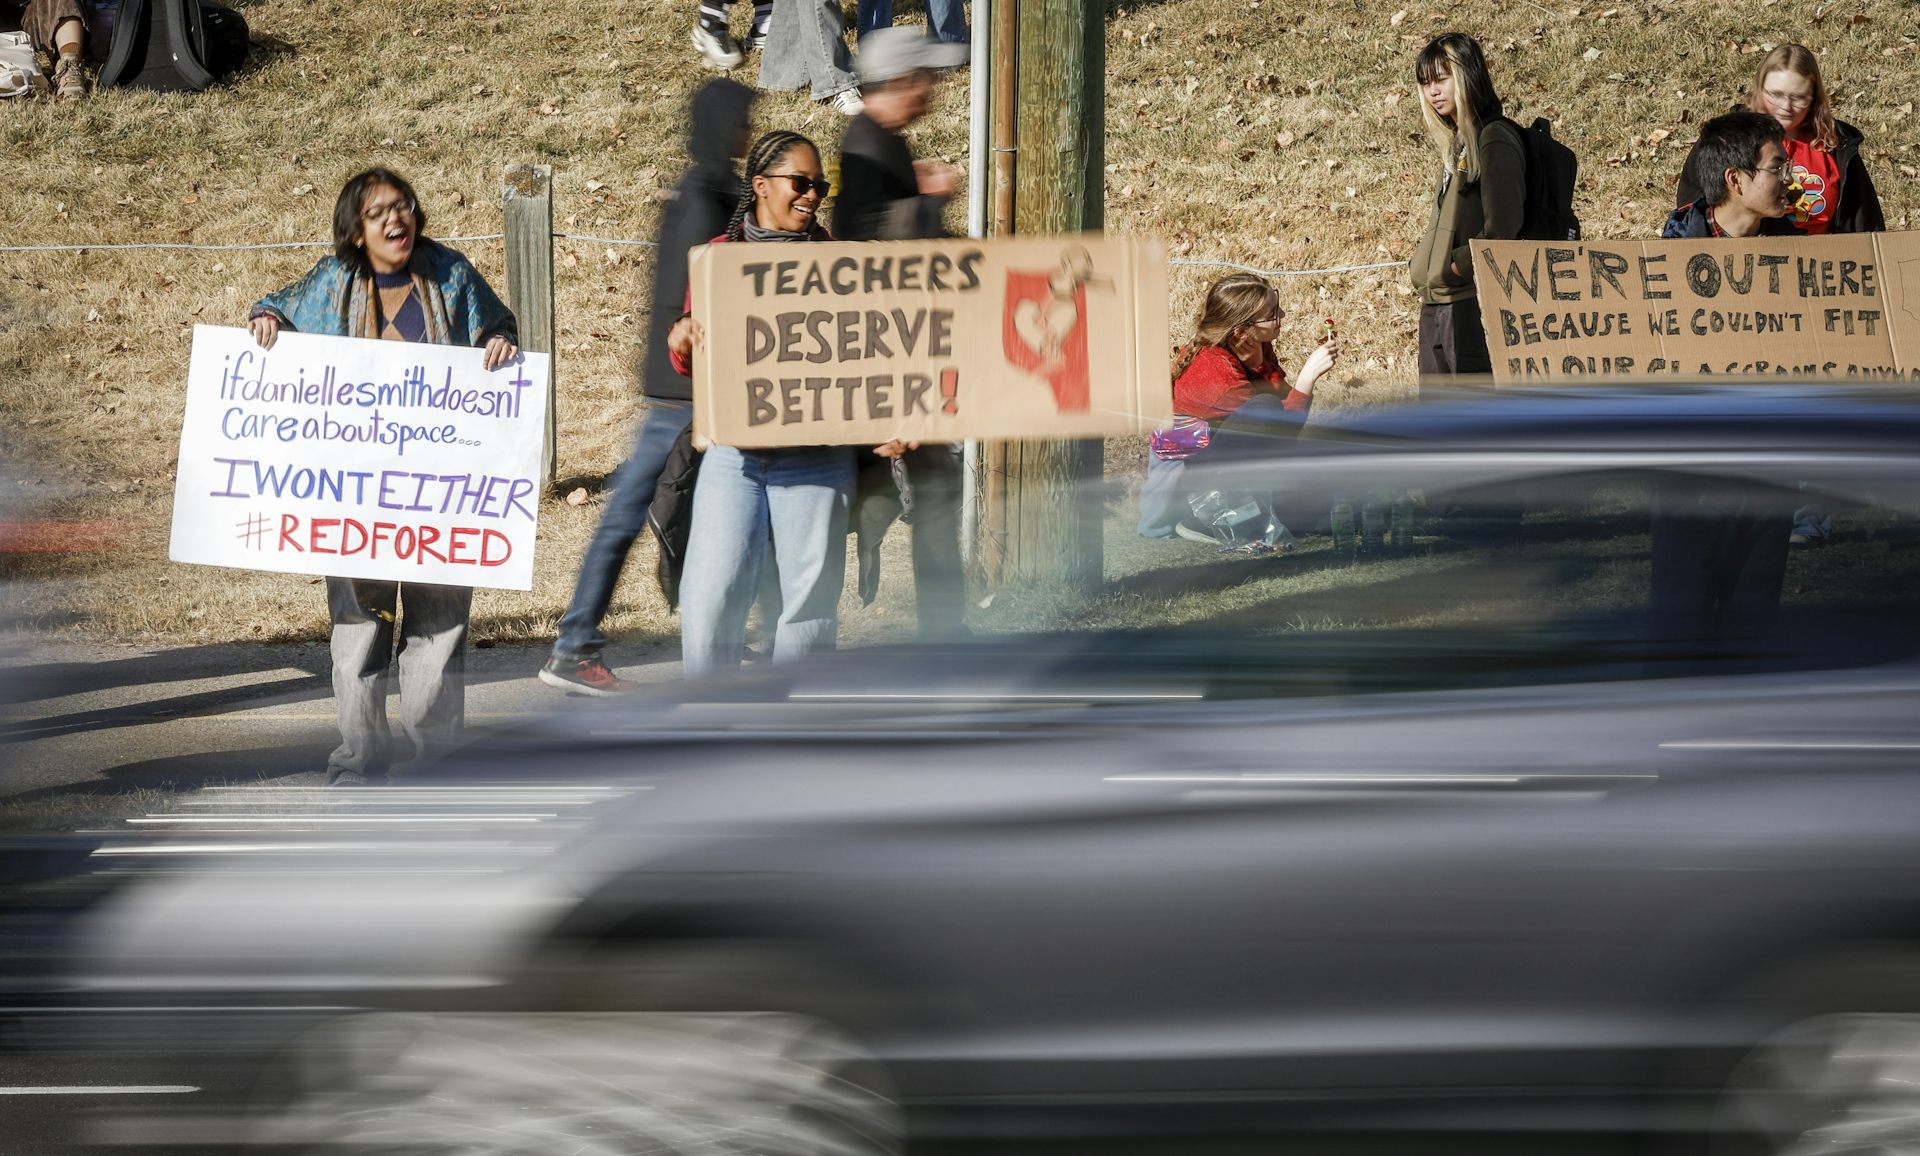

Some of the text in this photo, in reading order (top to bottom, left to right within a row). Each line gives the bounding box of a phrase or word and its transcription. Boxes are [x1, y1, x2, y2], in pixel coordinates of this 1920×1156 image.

[740, 249, 985, 298] TEACHERS
[1482, 246, 1876, 303] WE'RE OUT HERE
[745, 307, 955, 365] DESERVE
[1499, 308, 1881, 347] BECAUSE WE COULDN'T FIT
[745, 367, 959, 427] BETTER!
